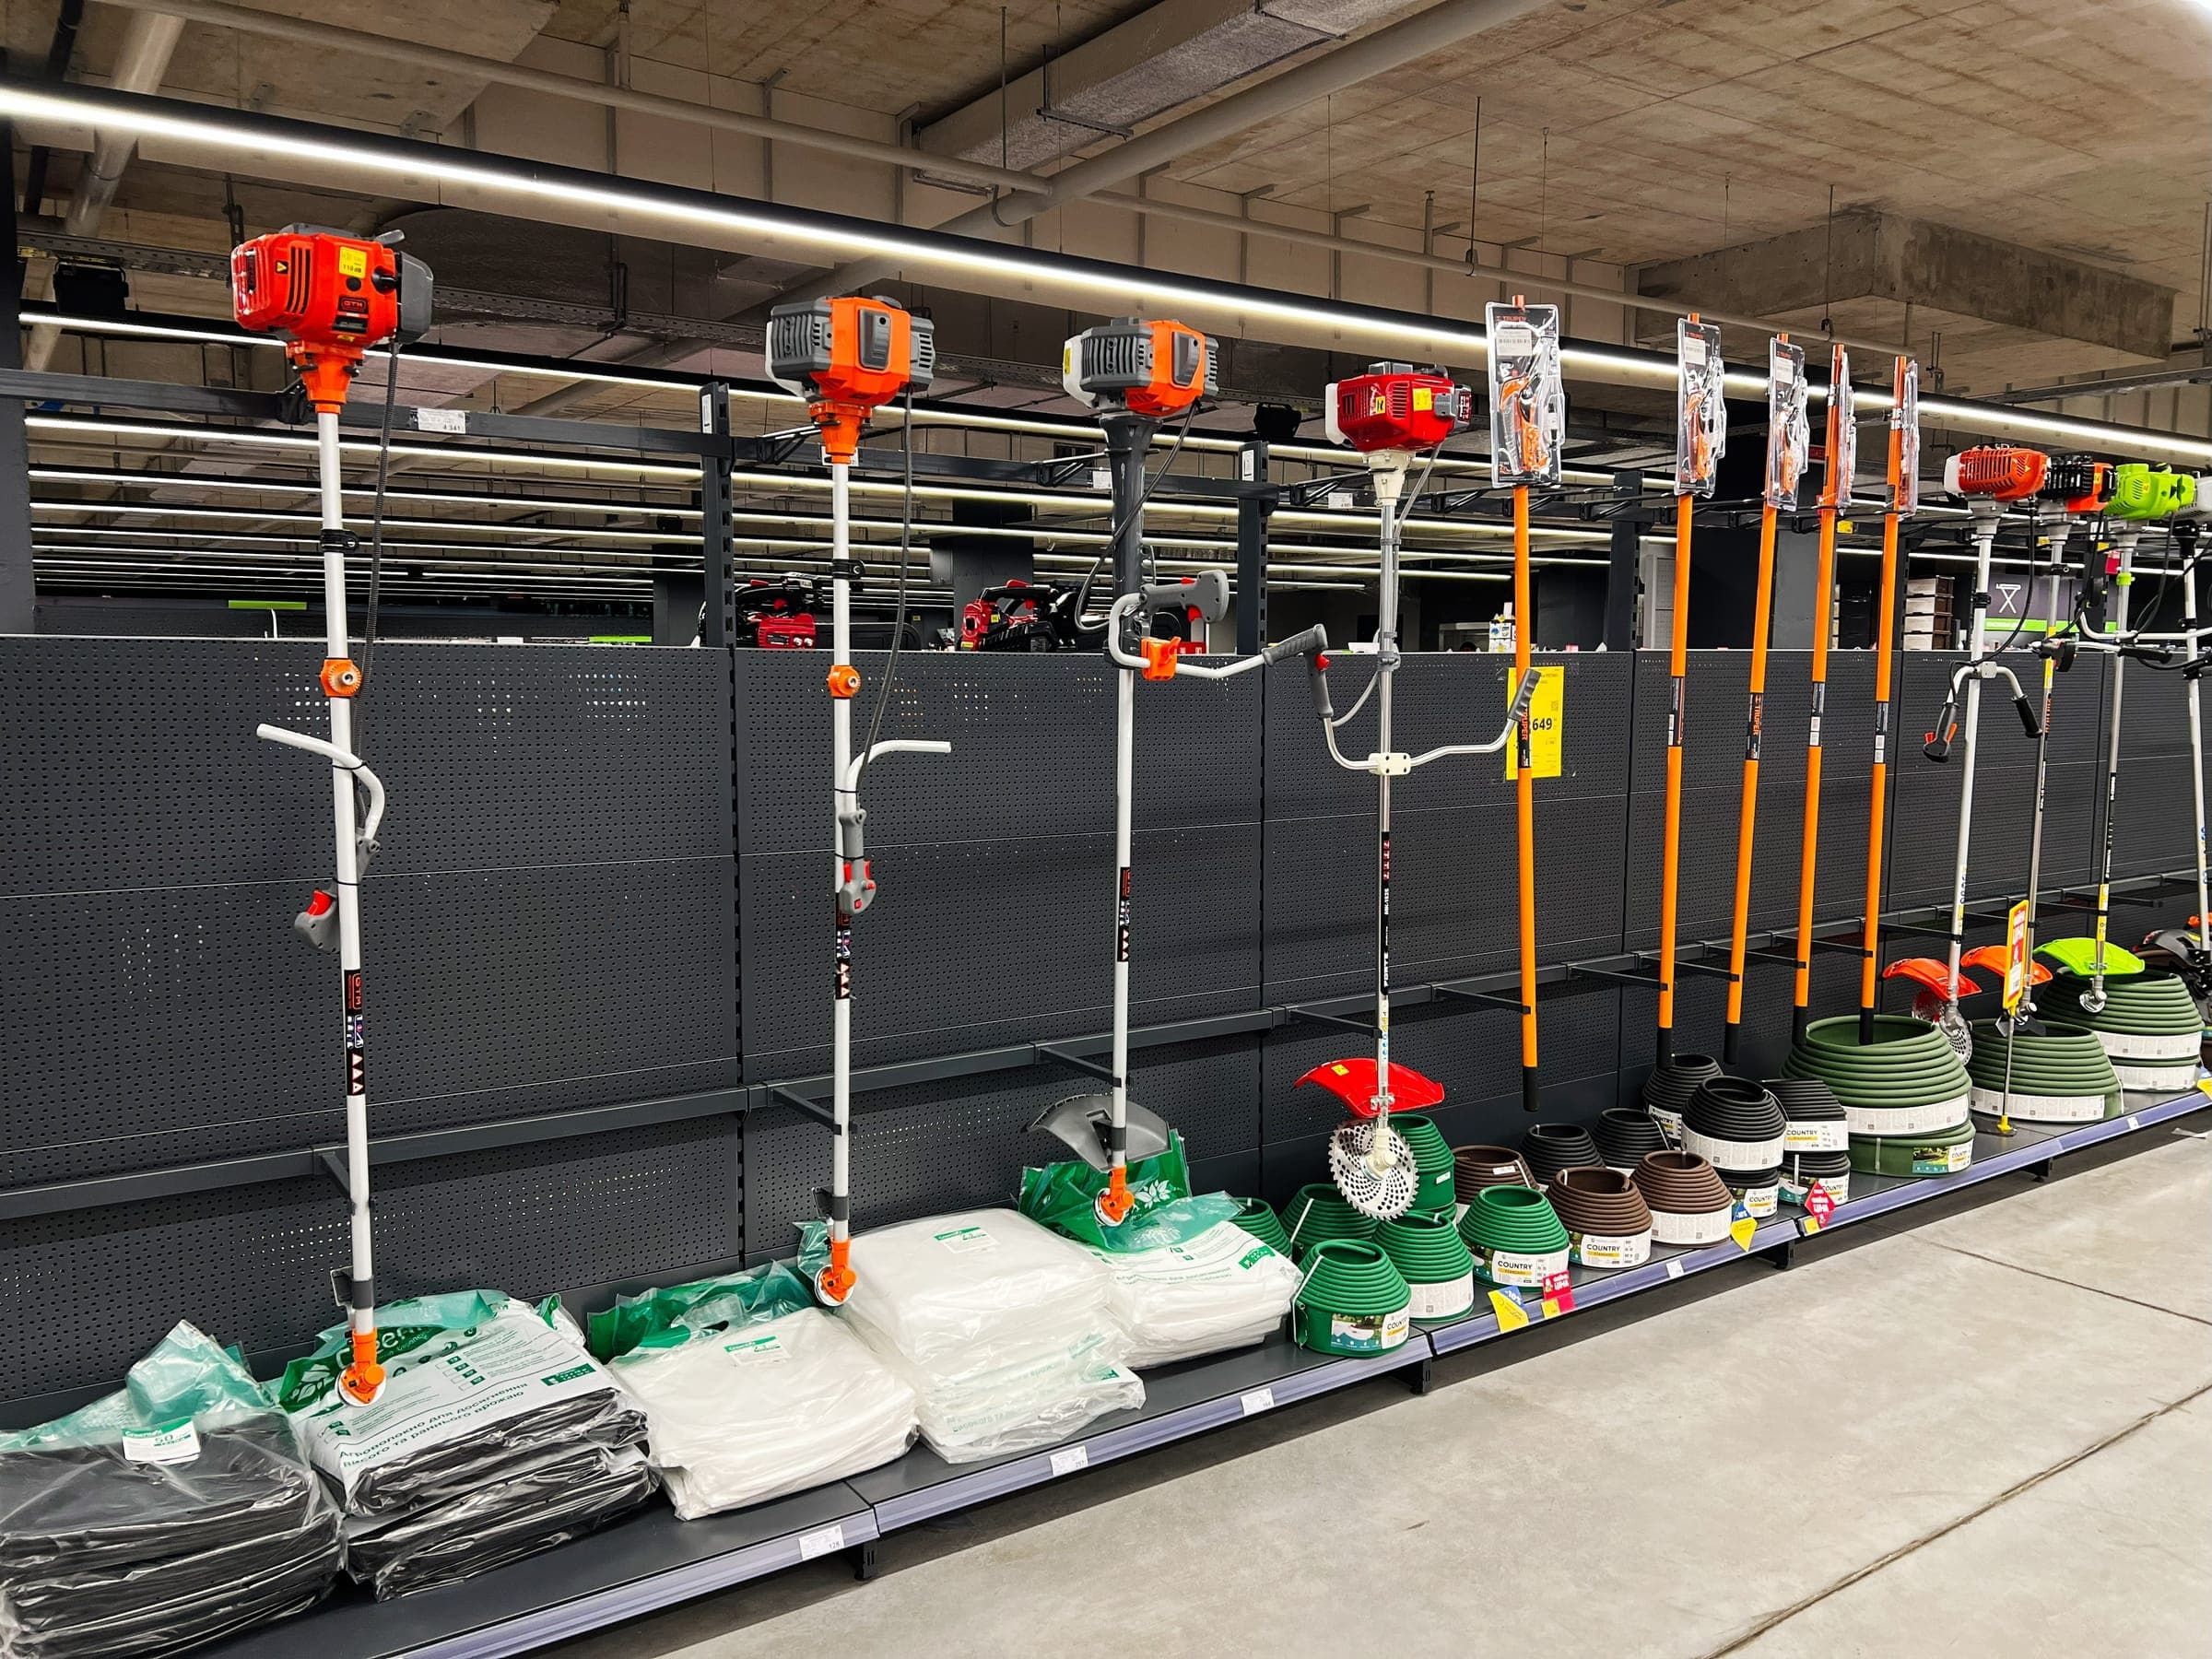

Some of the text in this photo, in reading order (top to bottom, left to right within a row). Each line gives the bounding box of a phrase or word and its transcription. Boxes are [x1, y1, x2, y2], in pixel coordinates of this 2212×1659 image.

[1532, 717, 1553, 731] 649
[1753, 706, 1761, 735] TRUPER
[1586, 1243, 1621, 1252] COUNTRY
[1497, 1260, 1533, 1270] COUNTRY
[1504, 1289, 1523, 1306] -10%
[429, 1411, 453, 1424] для
[456, 1382, 528, 1415] досягнення
[393, 1437, 407, 1446] та
[411, 1412, 471, 1440] раннього
[474, 1391, 524, 1414] врожаю
